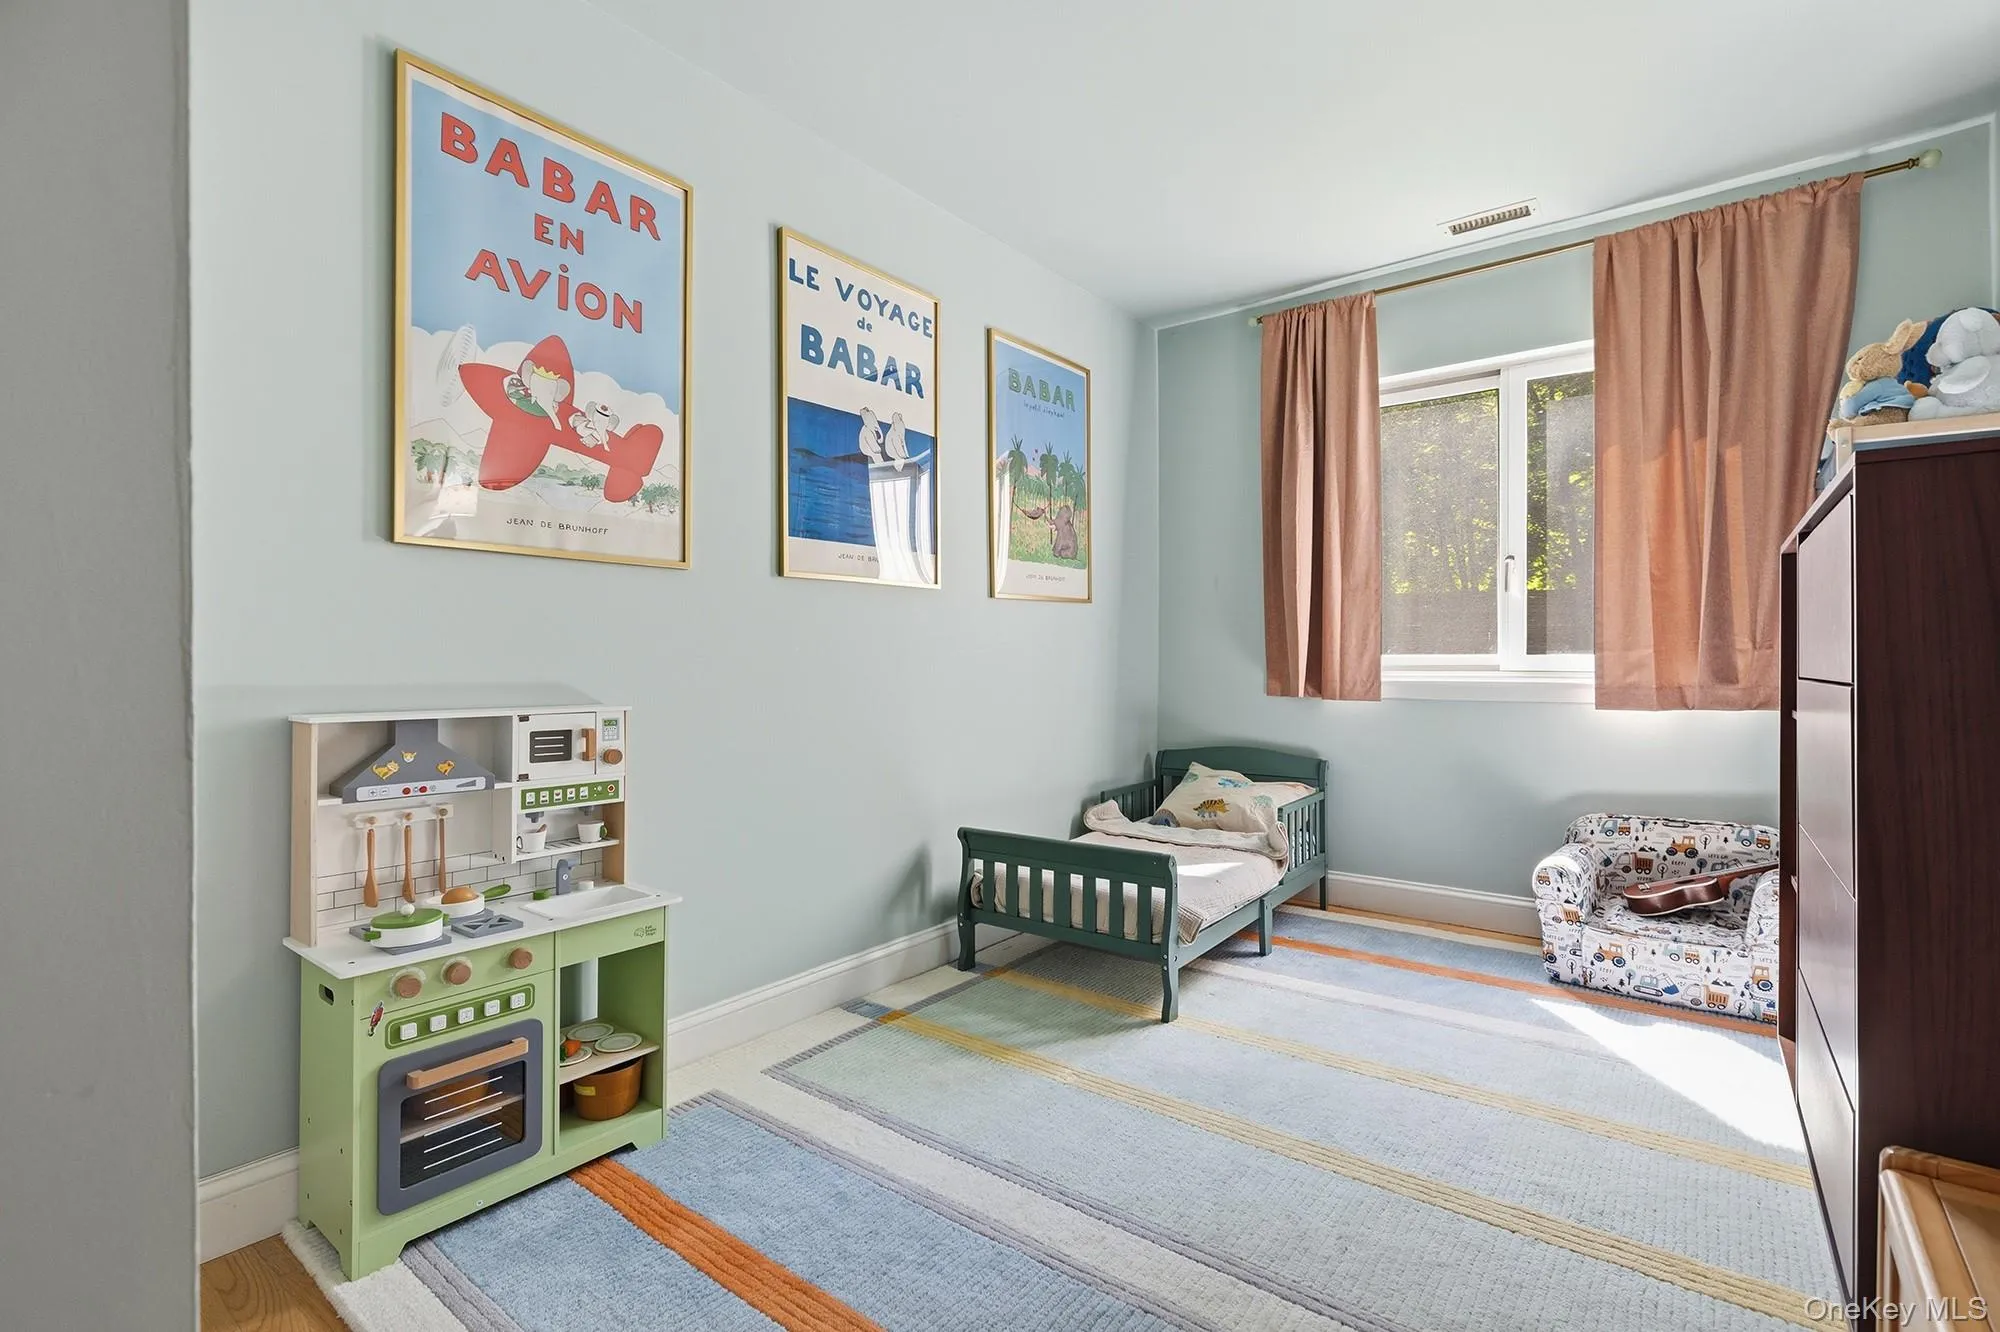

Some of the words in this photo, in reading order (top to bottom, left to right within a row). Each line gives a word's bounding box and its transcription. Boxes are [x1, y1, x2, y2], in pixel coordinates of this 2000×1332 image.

[440, 111, 662, 241] BABAR
[534, 212, 585, 256] EN
[788, 257, 820, 292] LE
[834, 276, 933, 339] VOYAGE
[856, 316, 873, 333] de
[800, 323, 924, 400] BABAR
[1007, 367, 1076, 413] BABAR
[506, 517, 534, 526] JEAN
[540, 520, 552, 529] DE
[558, 522, 609, 535] BRUNHOFF
